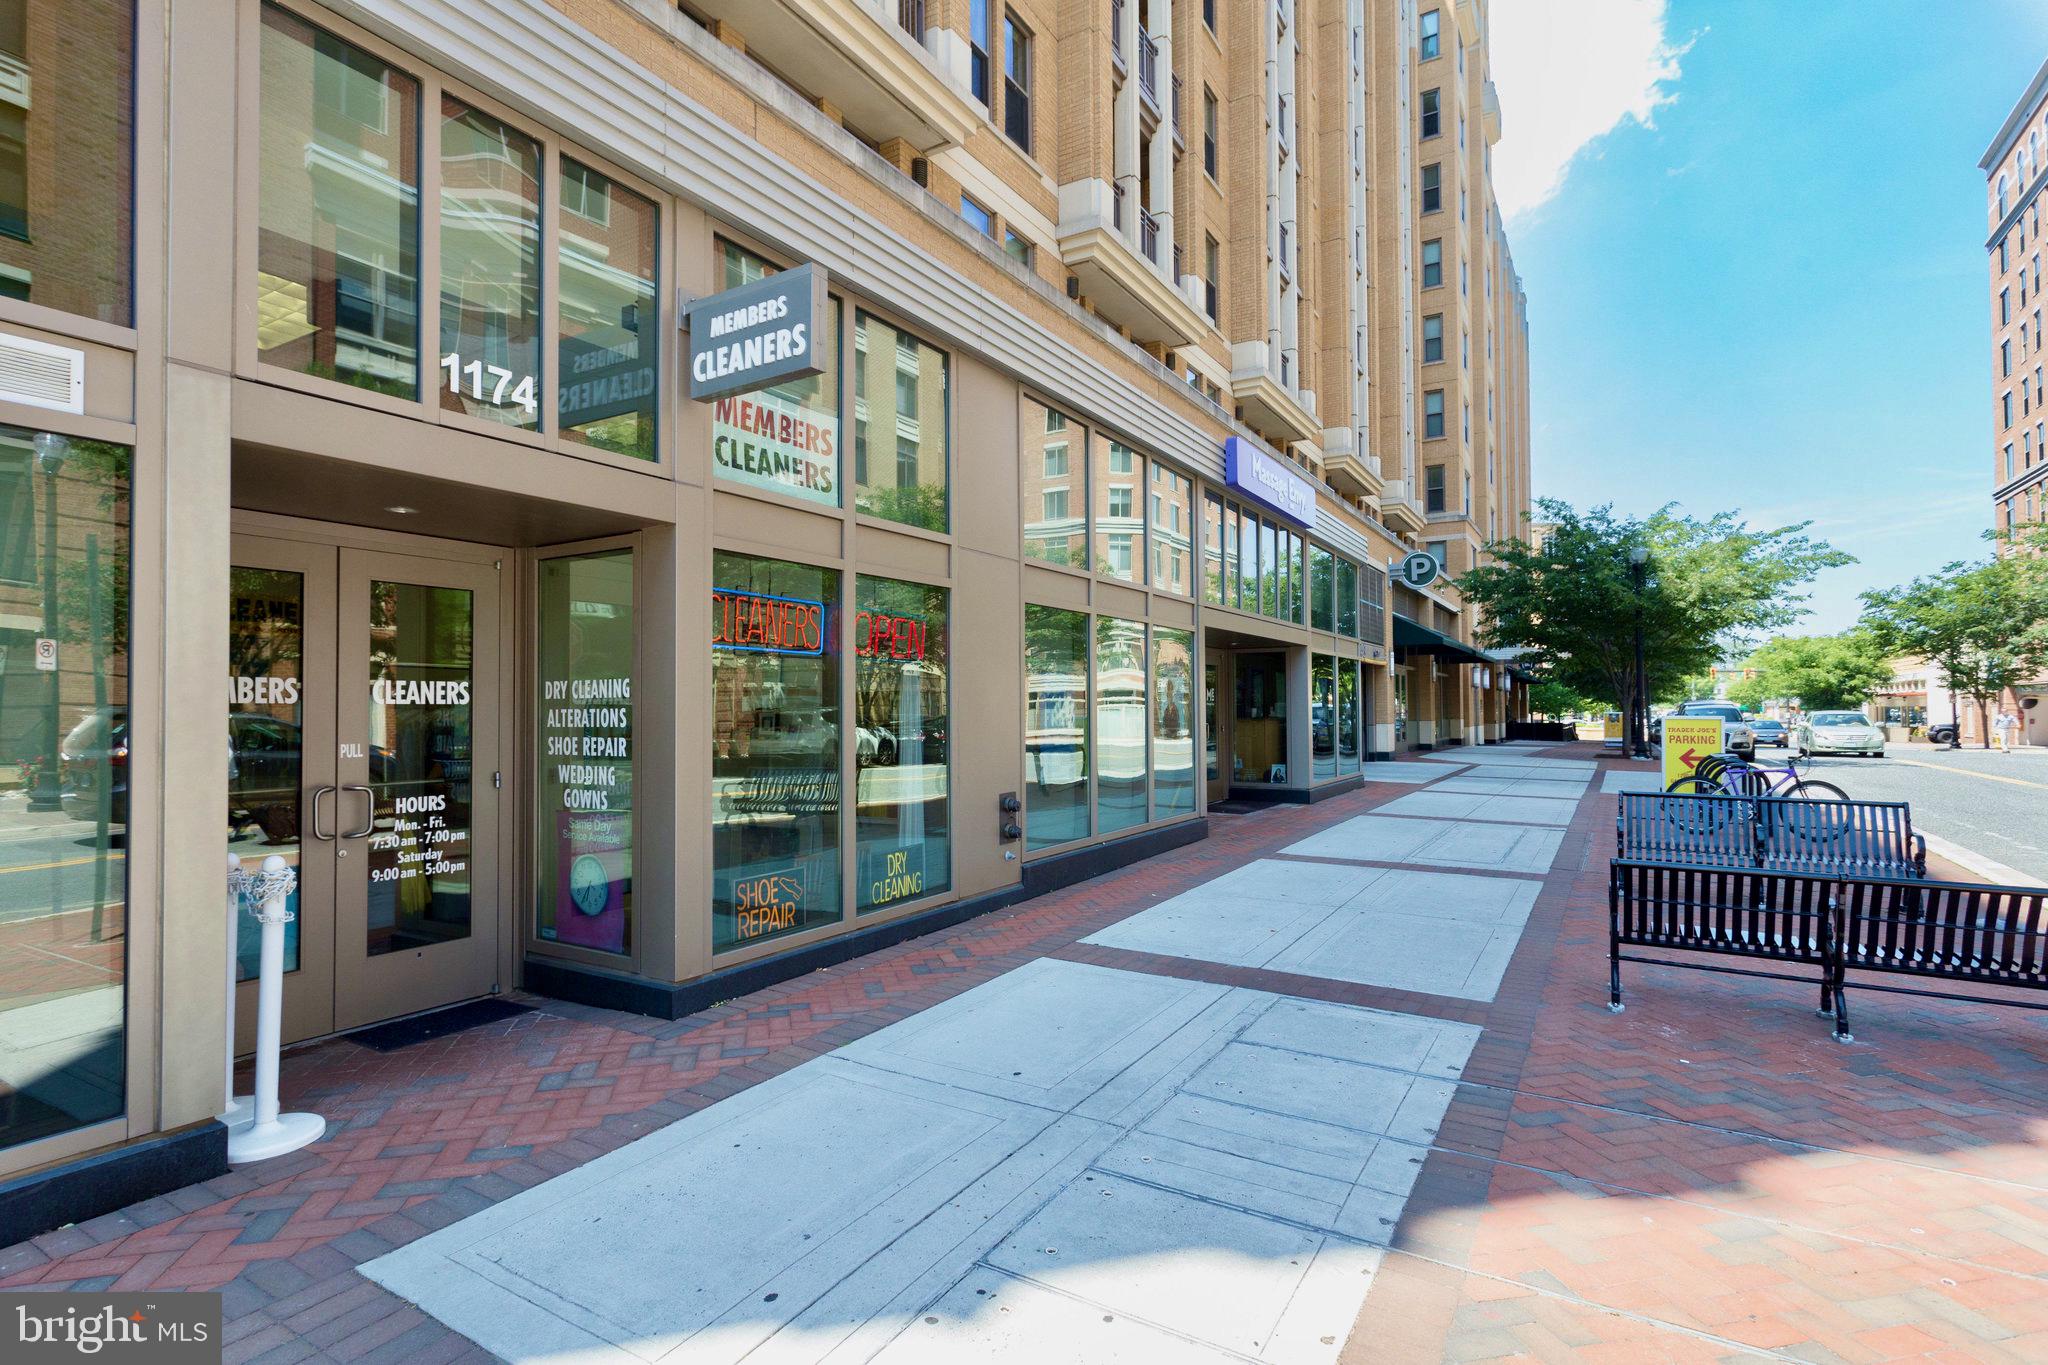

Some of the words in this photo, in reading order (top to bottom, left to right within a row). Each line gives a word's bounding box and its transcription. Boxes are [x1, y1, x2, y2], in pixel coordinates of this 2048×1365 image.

[710, 295, 788, 338] MEMBERS
[693, 323, 807, 382] CLEANERS
[441, 352, 538, 414] 1174
[715, 396, 833, 456] MEMBERS
[715, 435, 833, 493] CLEANERS
[1410, 557, 1431, 581] P
[855, 611, 926, 660] OPEN
[372, 680, 470, 705] CLEANERS
[545, 680, 568, 699] DRY
[571, 678, 630, 699] CLEANING
[547, 707, 627, 728] ALTERATIONS
[340, 743, 364, 759] PULL
[548, 736, 578, 756] SHOE
[582, 736, 627, 757] REPAIR
[1669, 734, 1716, 745] PARKING
[558, 764, 616, 786] WEDDING
[395, 794, 446, 814] HOURS
[563, 788, 608, 810] GOWNS
[394, 818, 421, 832] Mon.
[429, 816, 446, 829] Fri.
[594, 820, 611, 834] Day
[373, 834, 399, 850] 7:30
[400, 836, 417, 847] am
[424, 829, 450, 844] 7:00
[450, 831, 466, 843] pm
[397, 847, 443, 864] Saturday
[887, 850, 907, 877] DRY
[371, 867, 399, 883] 9:00
[400, 868, 416, 879] am
[425, 860, 450, 876] 5:00
[450, 861, 466, 874] pm
[737, 876, 779, 912] SHOE
[871, 871, 922, 905] CLEANING
[737, 901, 797, 940] REPAIR
